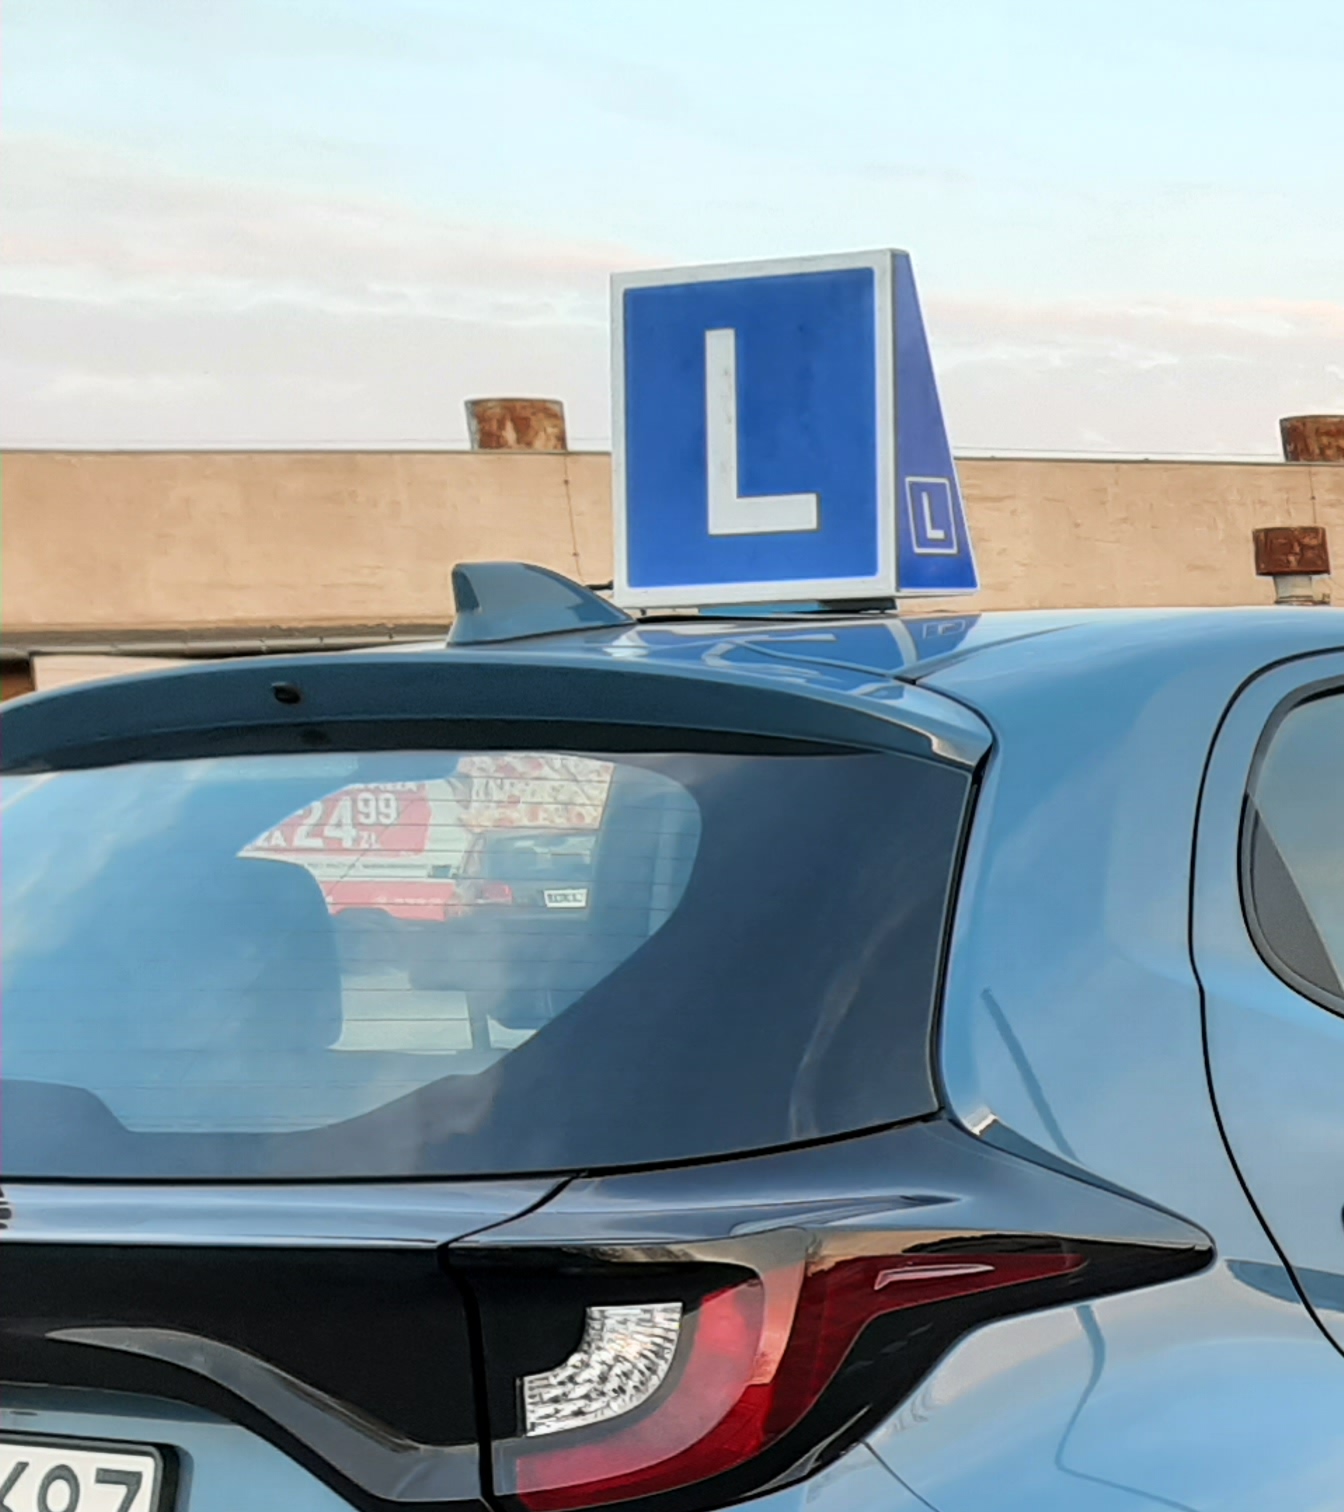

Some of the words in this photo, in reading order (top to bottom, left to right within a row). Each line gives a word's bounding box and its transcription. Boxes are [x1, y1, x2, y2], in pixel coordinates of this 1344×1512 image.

[705, 328, 817, 535] L
[923, 492, 944, 539] L
[357, 793, 397, 825] 99
